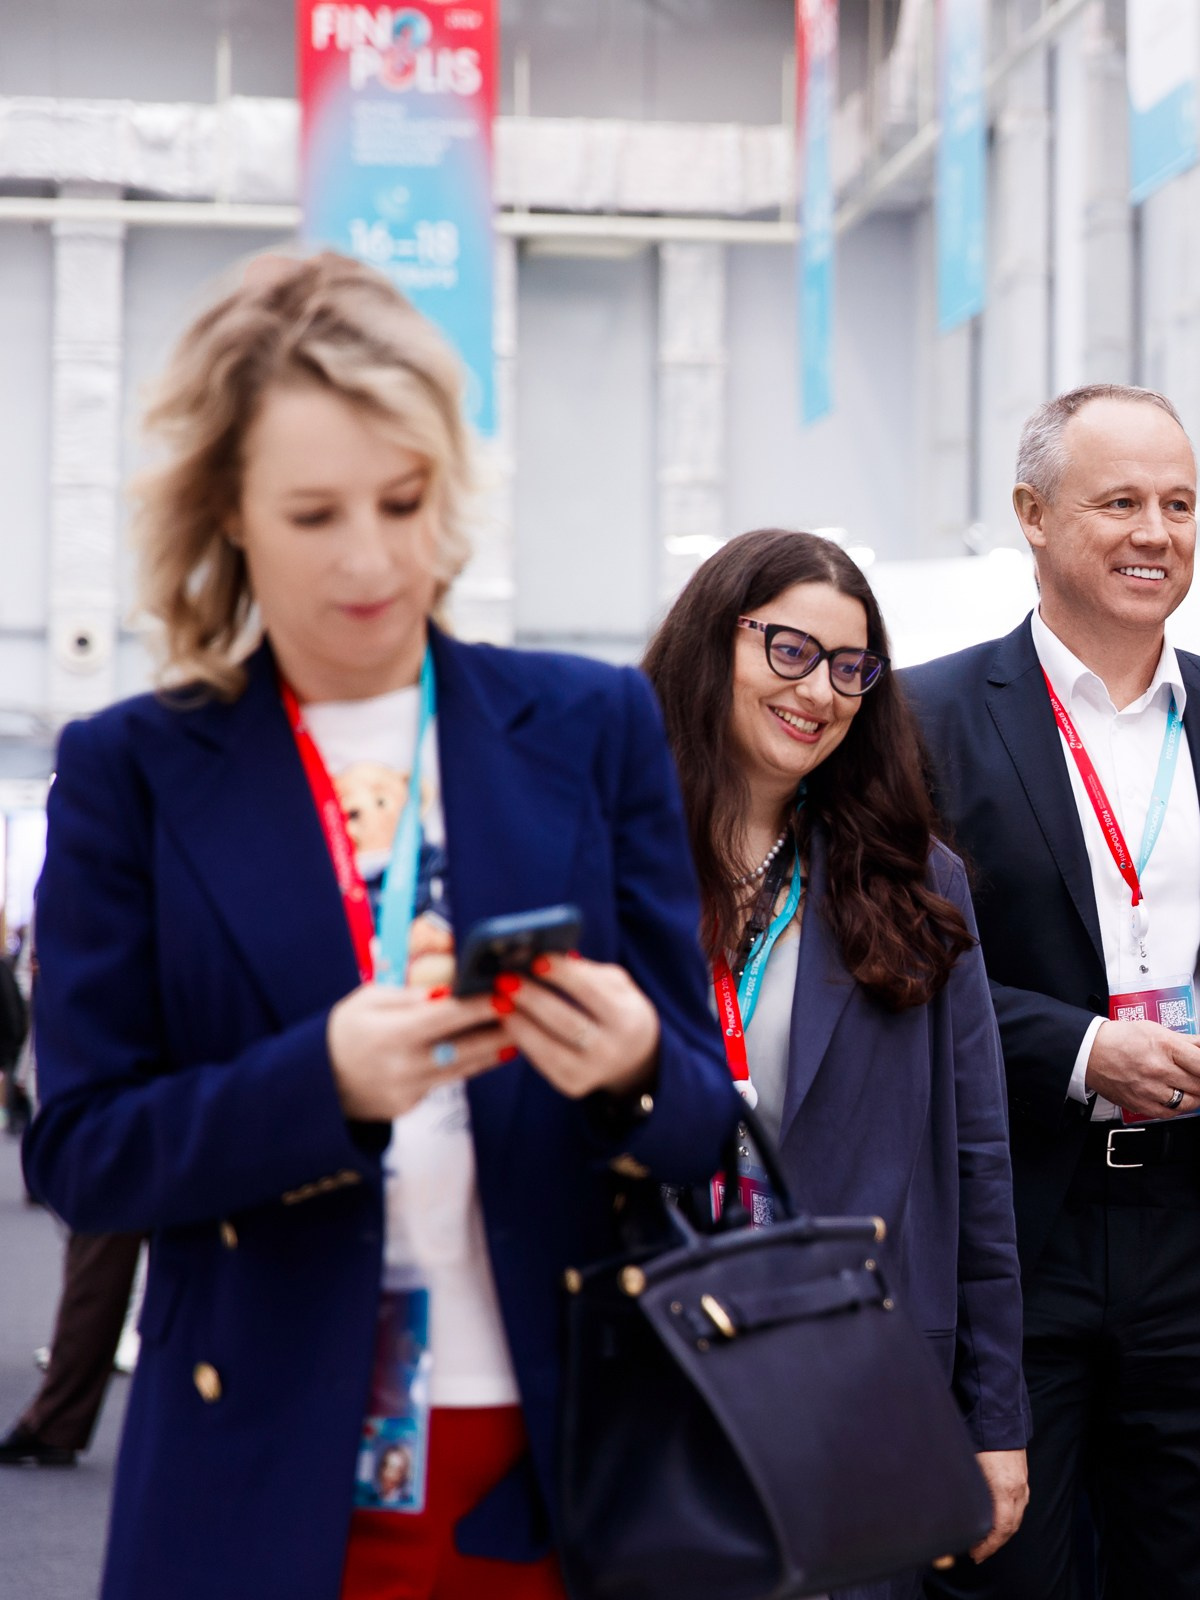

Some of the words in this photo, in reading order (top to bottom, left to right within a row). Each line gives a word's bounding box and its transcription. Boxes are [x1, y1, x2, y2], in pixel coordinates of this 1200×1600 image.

[1057, 711, 1077, 743] FINOPOLIS
[1102, 809, 1113, 827] 2024
[1108, 827, 1127, 862] FINOPOLIS
[745, 977, 757, 997] 2024
[723, 991, 736, 1030] FINOPOLIS
